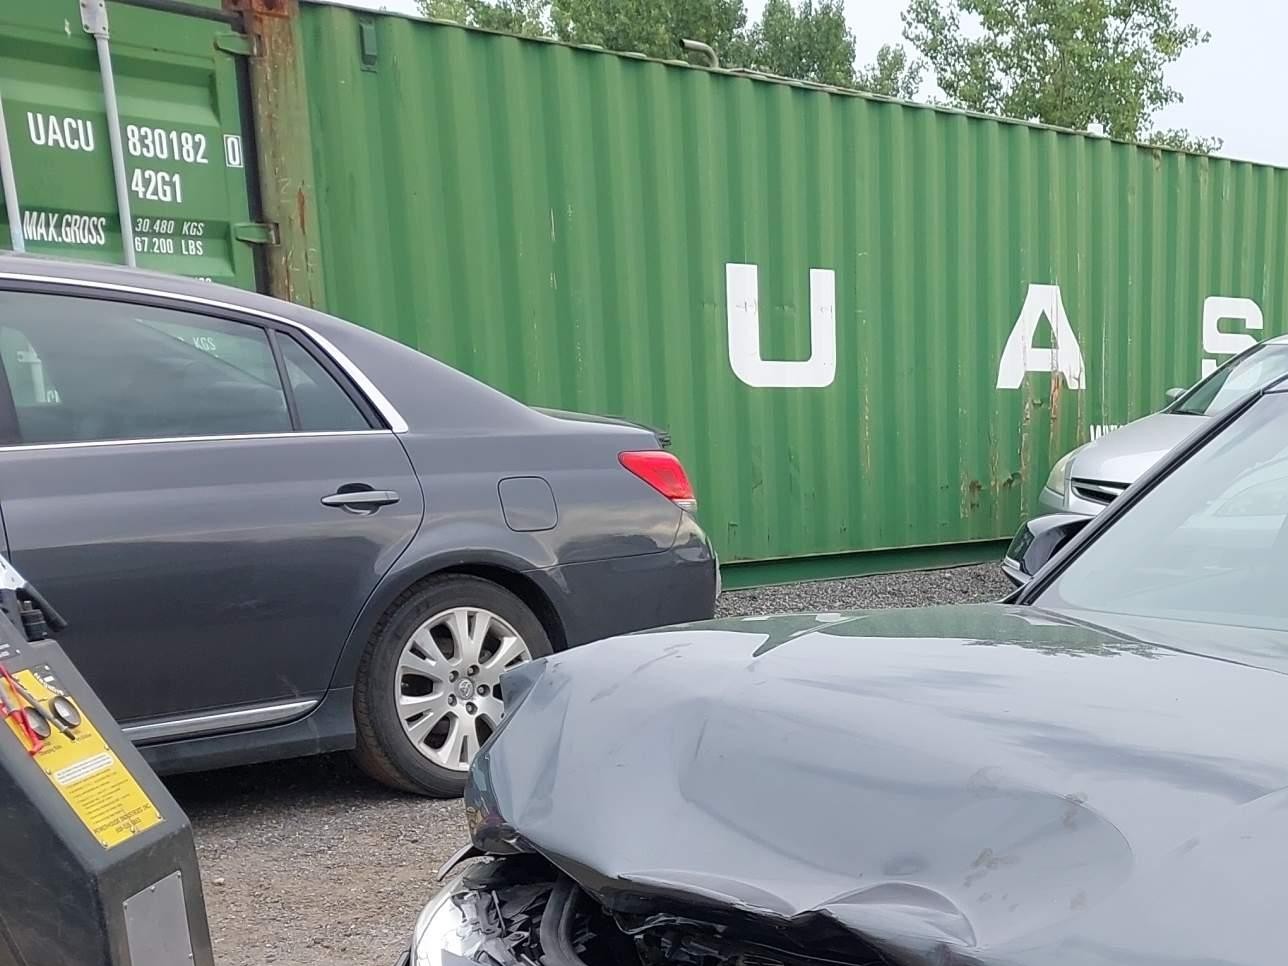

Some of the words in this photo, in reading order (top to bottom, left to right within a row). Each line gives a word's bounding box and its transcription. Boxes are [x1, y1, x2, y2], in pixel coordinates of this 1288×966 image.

[27, 112, 95, 151] UACU
[126, 125, 208, 164] 830182
[131, 169, 183, 203] 42G1
[24, 211, 106, 245] MAX.GROSS
[135, 218, 175, 234] 30.480
[182, 221, 205, 236] KGS
[134, 237, 174, 254] 67.200
[181, 239, 204, 256] LBS
